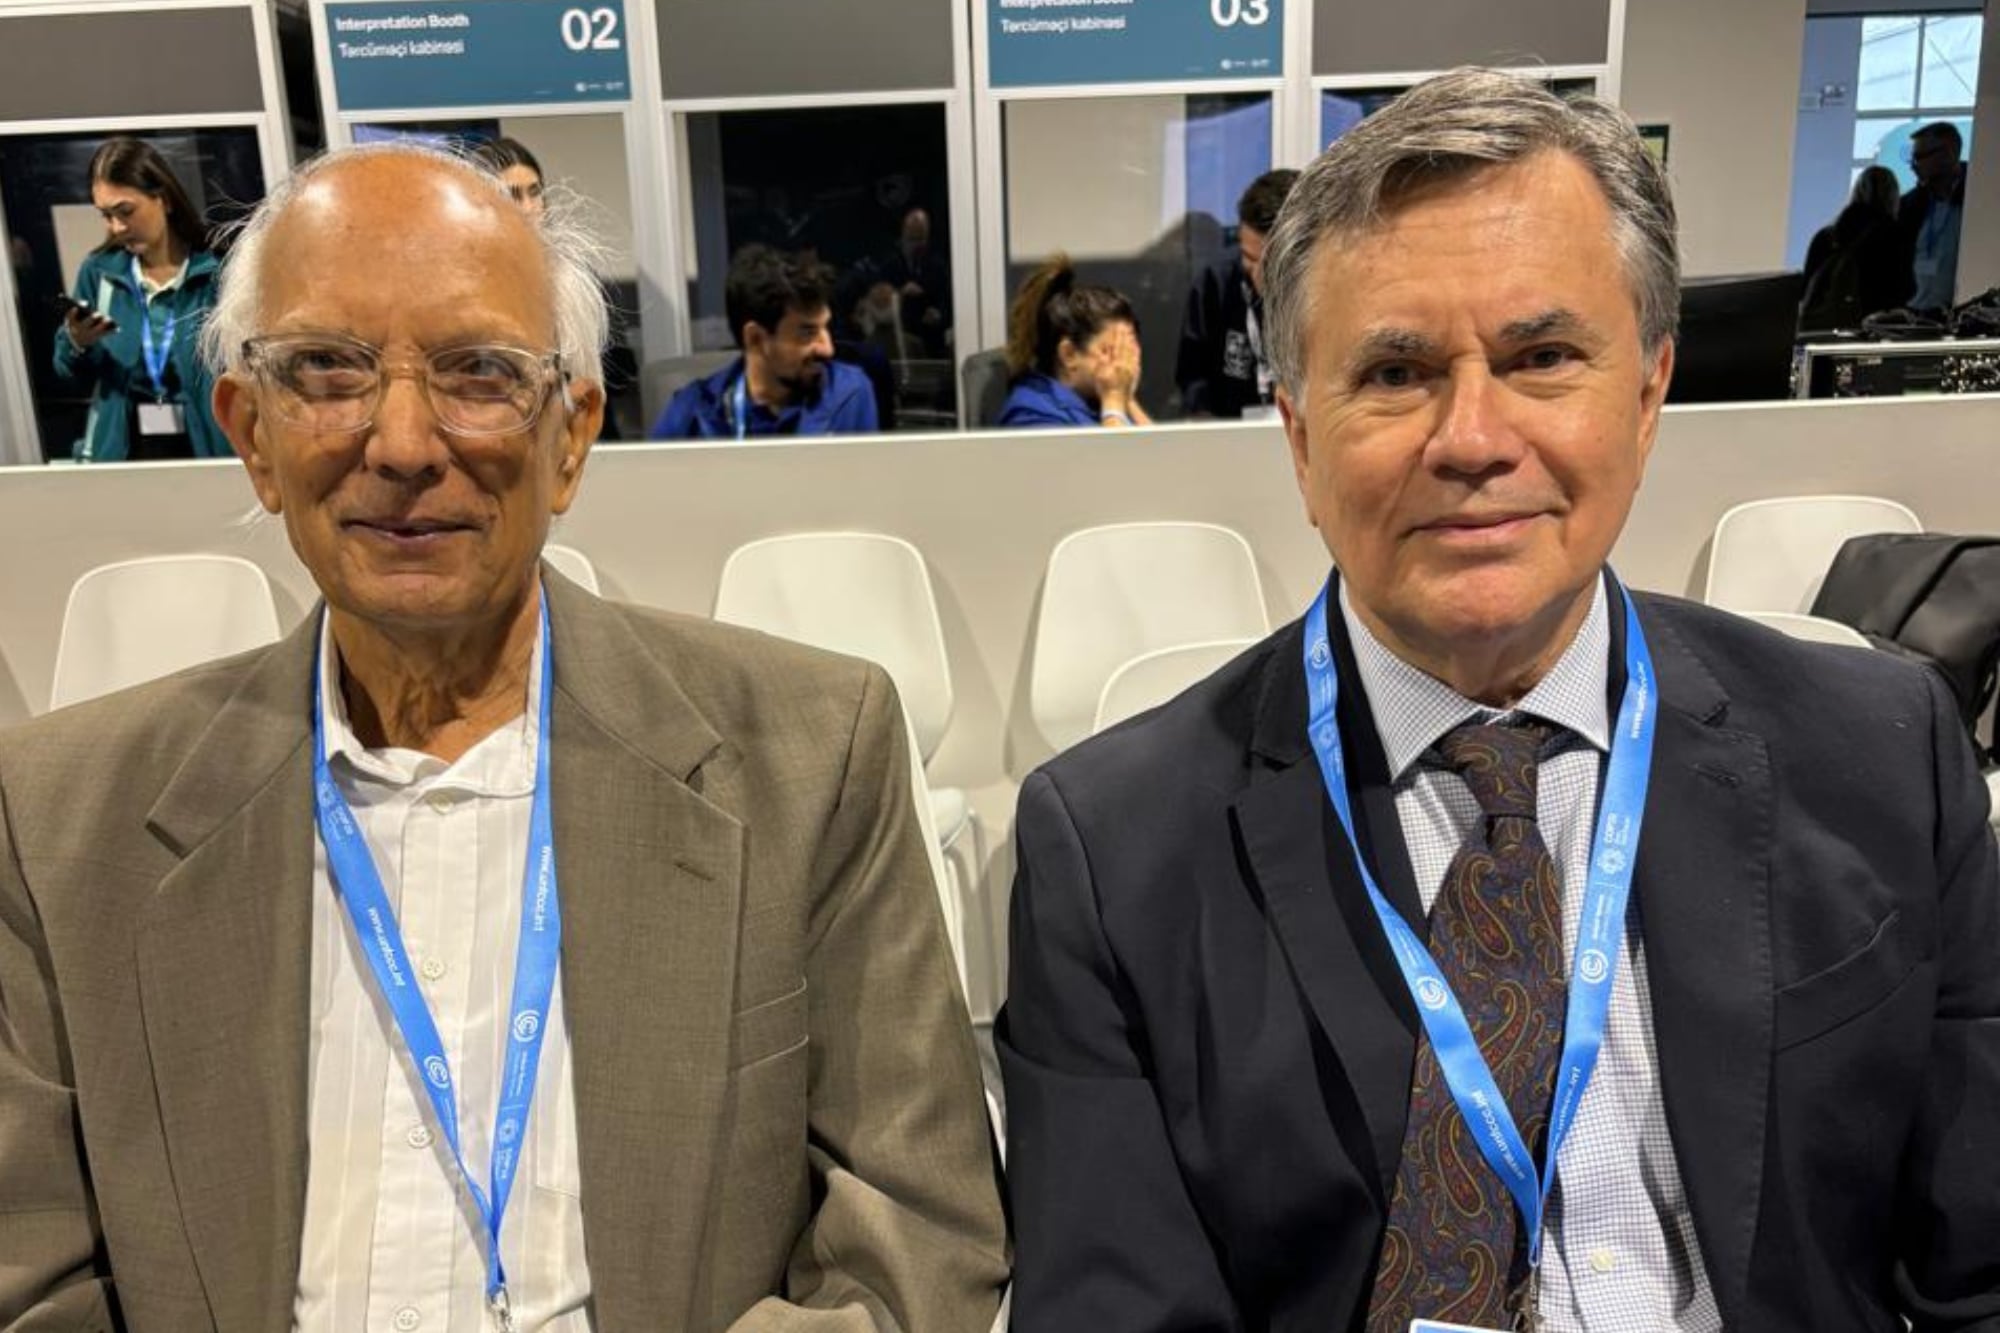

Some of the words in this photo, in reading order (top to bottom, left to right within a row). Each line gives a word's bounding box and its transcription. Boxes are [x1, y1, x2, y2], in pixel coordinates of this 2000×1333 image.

[335, 17, 427, 32] Interpretation
[428, 14, 470, 29] Booth
[1210, 0, 1269, 26] 03
[561, 8, 620, 50] 02
